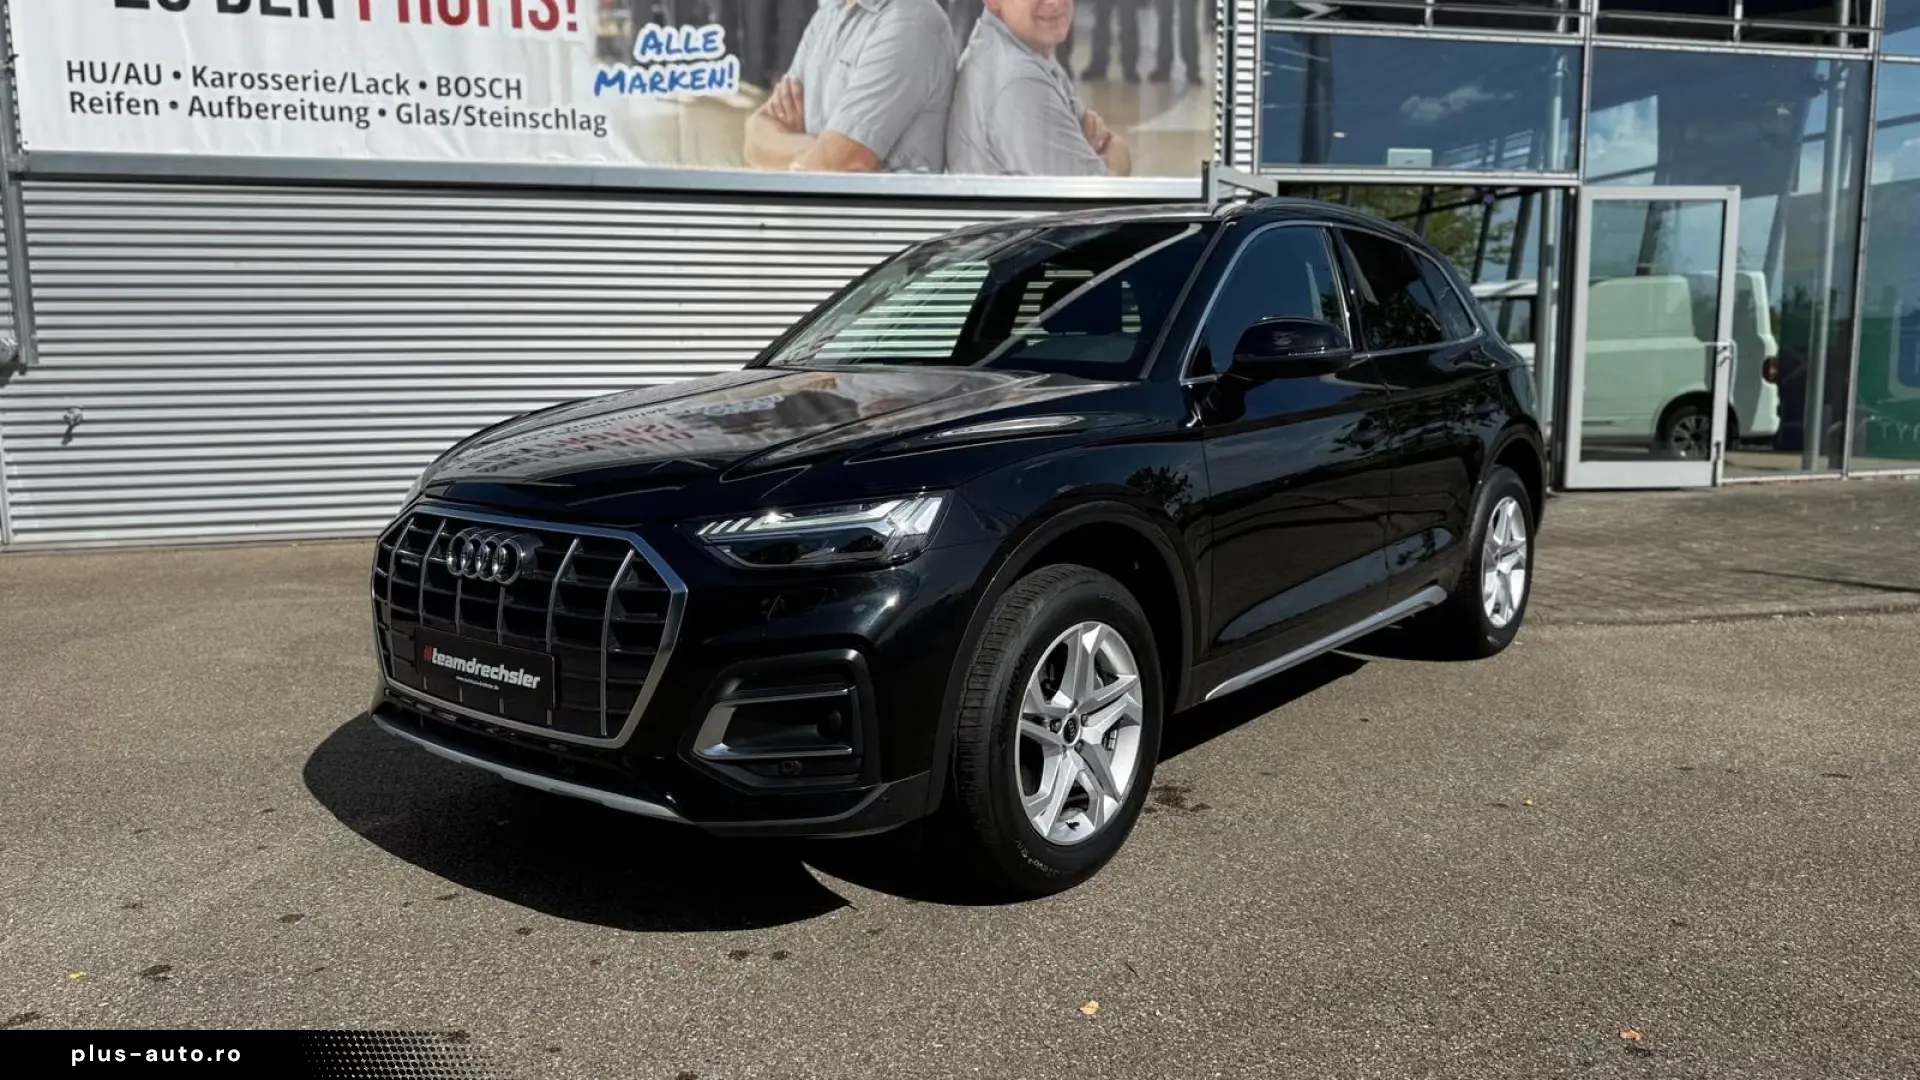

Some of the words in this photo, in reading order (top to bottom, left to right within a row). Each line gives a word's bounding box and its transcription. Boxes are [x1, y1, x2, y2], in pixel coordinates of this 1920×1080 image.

[640, 29, 719, 57] ALLE
[66, 60, 162, 86] HU/AU
[192, 65, 410, 96] Karosserie/Lack
[437, 76, 522, 100] BOSCH
[594, 61, 734, 97] MARKEN!
[69, 91, 160, 116] Reifen
[188, 95, 370, 130] Aufbereitung
[396, 103, 608, 138] Glas/Steinschlag
